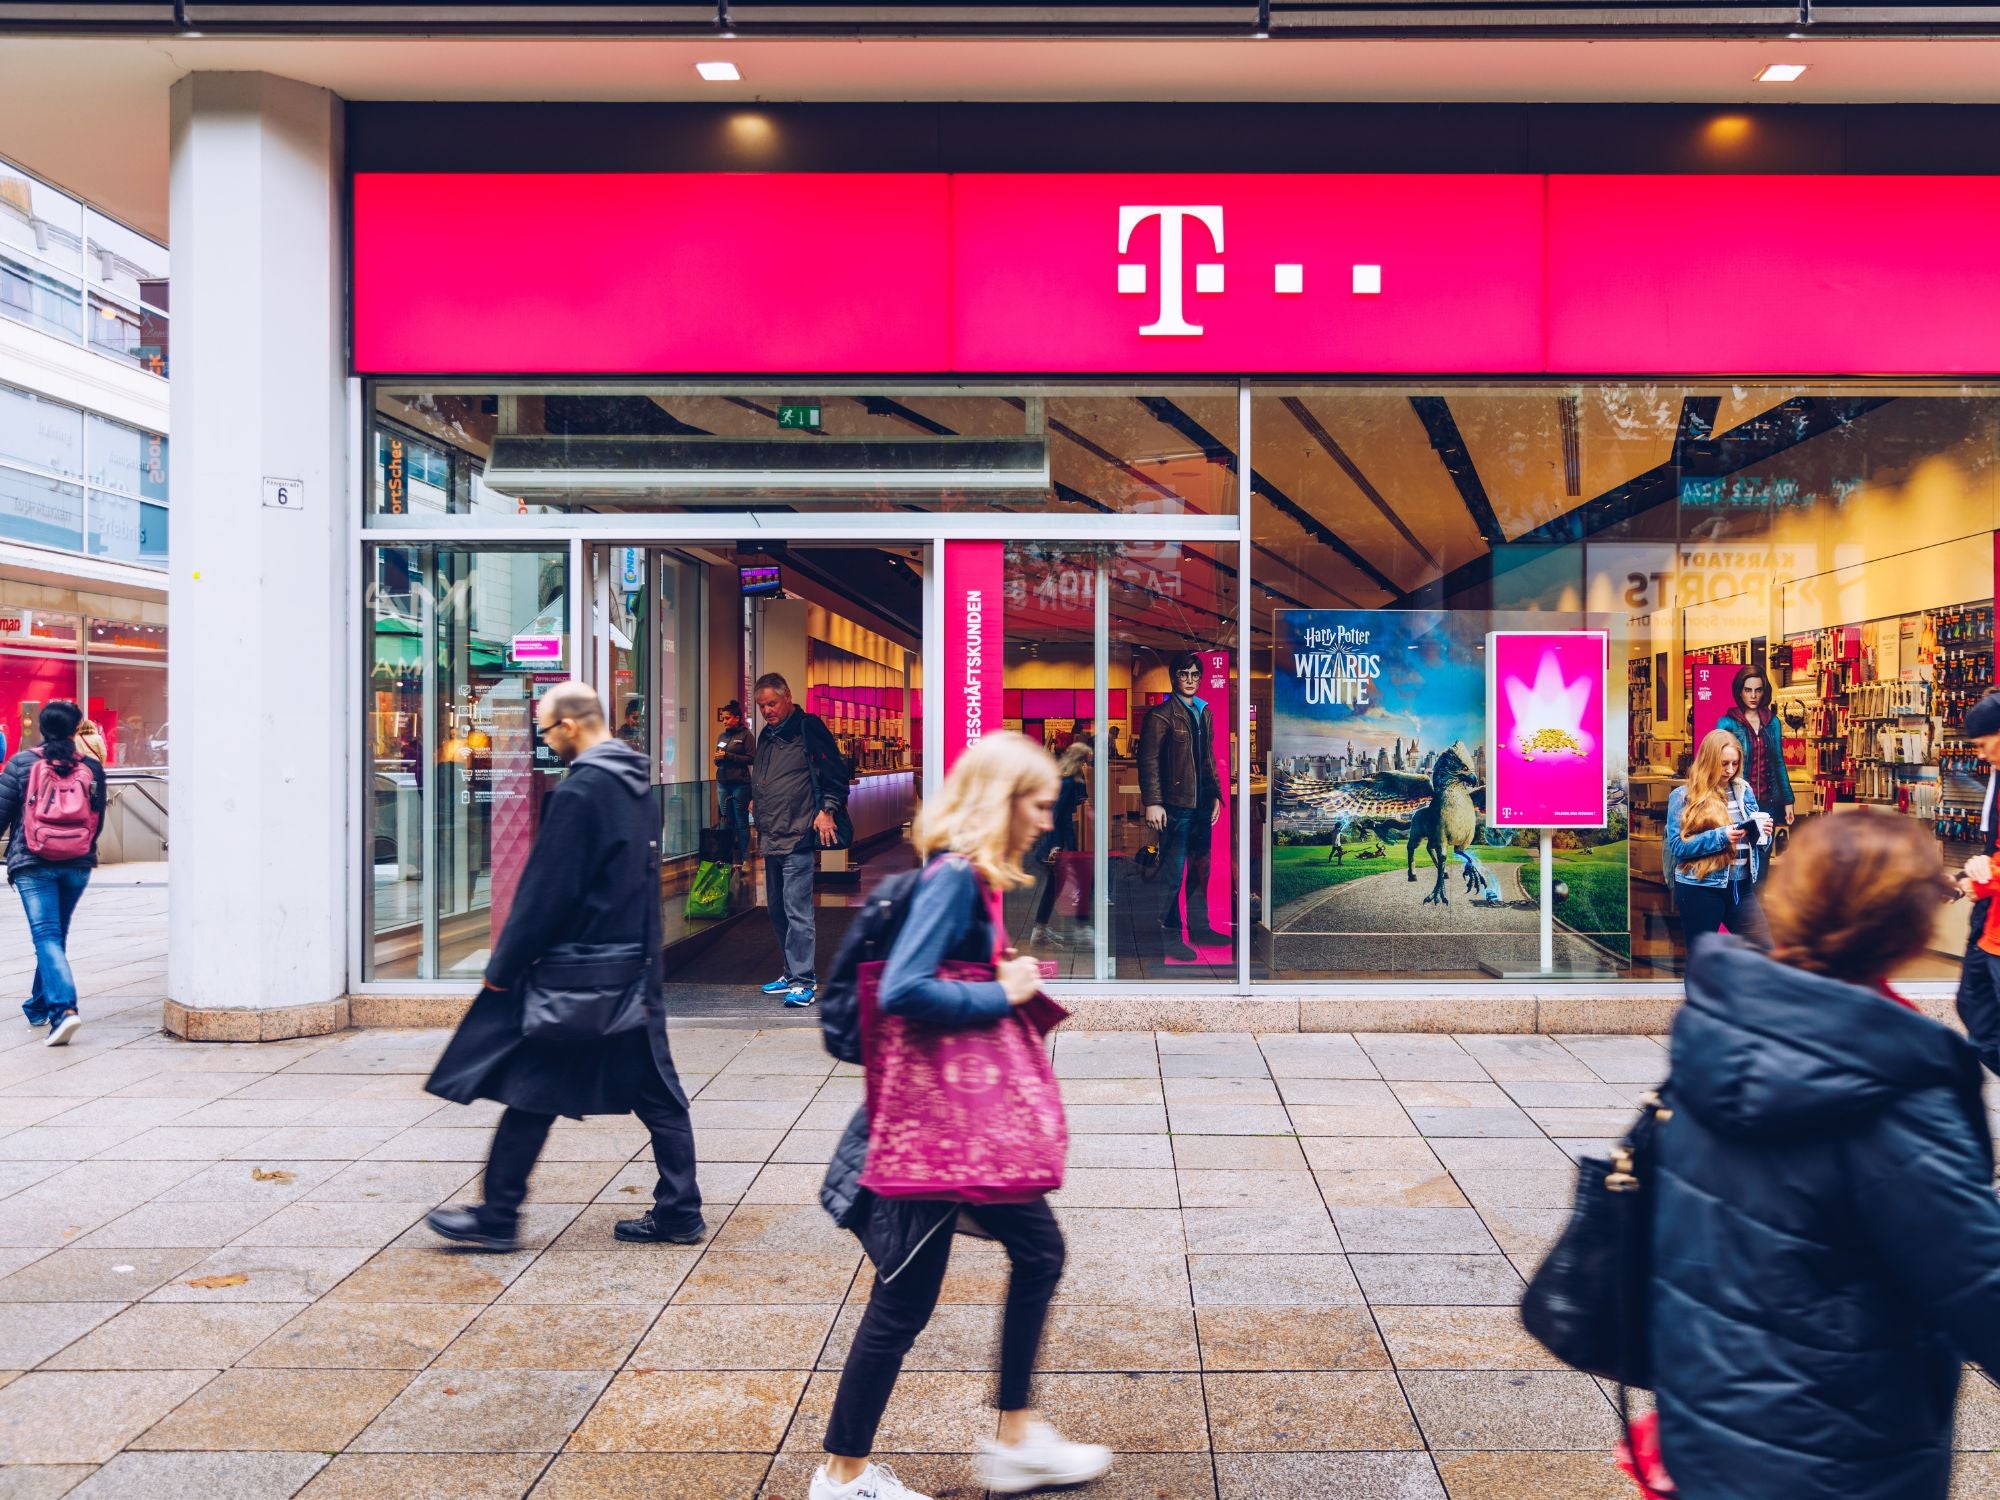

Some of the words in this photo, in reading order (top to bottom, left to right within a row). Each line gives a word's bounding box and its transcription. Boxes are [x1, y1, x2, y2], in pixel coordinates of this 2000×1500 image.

[1117, 205, 1225, 336] T
[386, 439, 402, 514] ortSchec
[278, 487, 288, 505] 6
[1304, 627, 1336, 648] Harry
[1337, 625, 1370, 646] Potter
[964, 590, 982, 749] GESCHÄFTSKUNDEN
[1294, 652, 1381, 678] WIZARDS
[1305, 678, 1370, 705] UNITE
